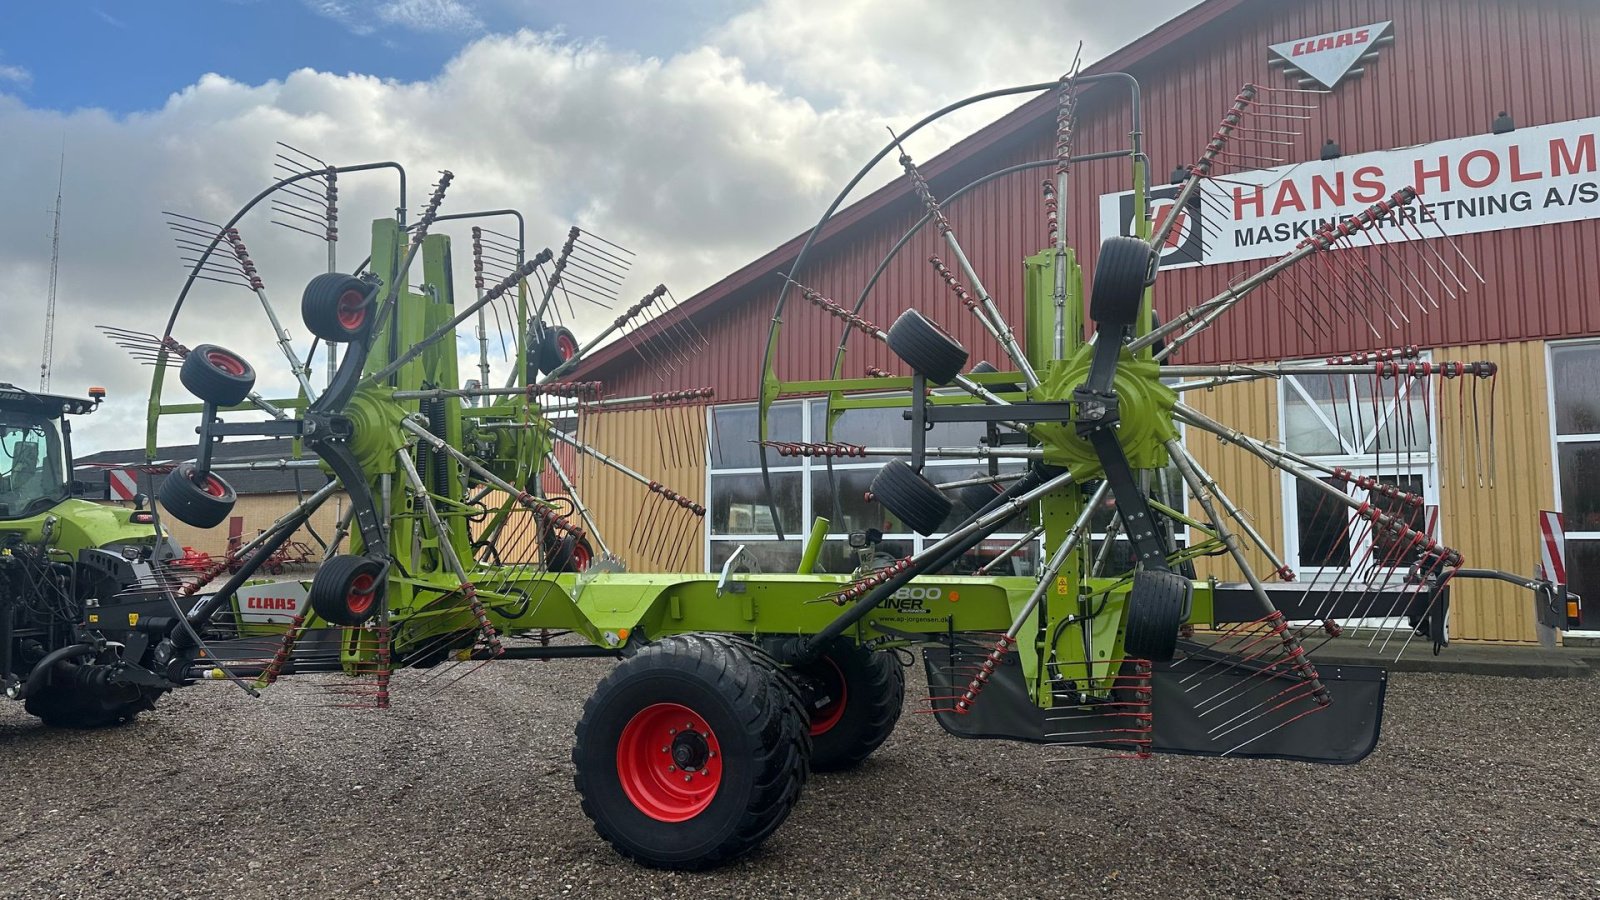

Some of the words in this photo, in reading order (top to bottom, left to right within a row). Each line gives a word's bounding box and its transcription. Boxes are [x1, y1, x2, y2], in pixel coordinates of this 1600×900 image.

[1292, 29, 1370, 57] CLAAS
[1233, 166, 1386, 221] HANS
[1414, 133, 1597, 196] HOLM
[1543, 182, 1599, 209] A/S
[248, 597, 296, 610] CLAAS
[888, 587, 941, 600] 800
